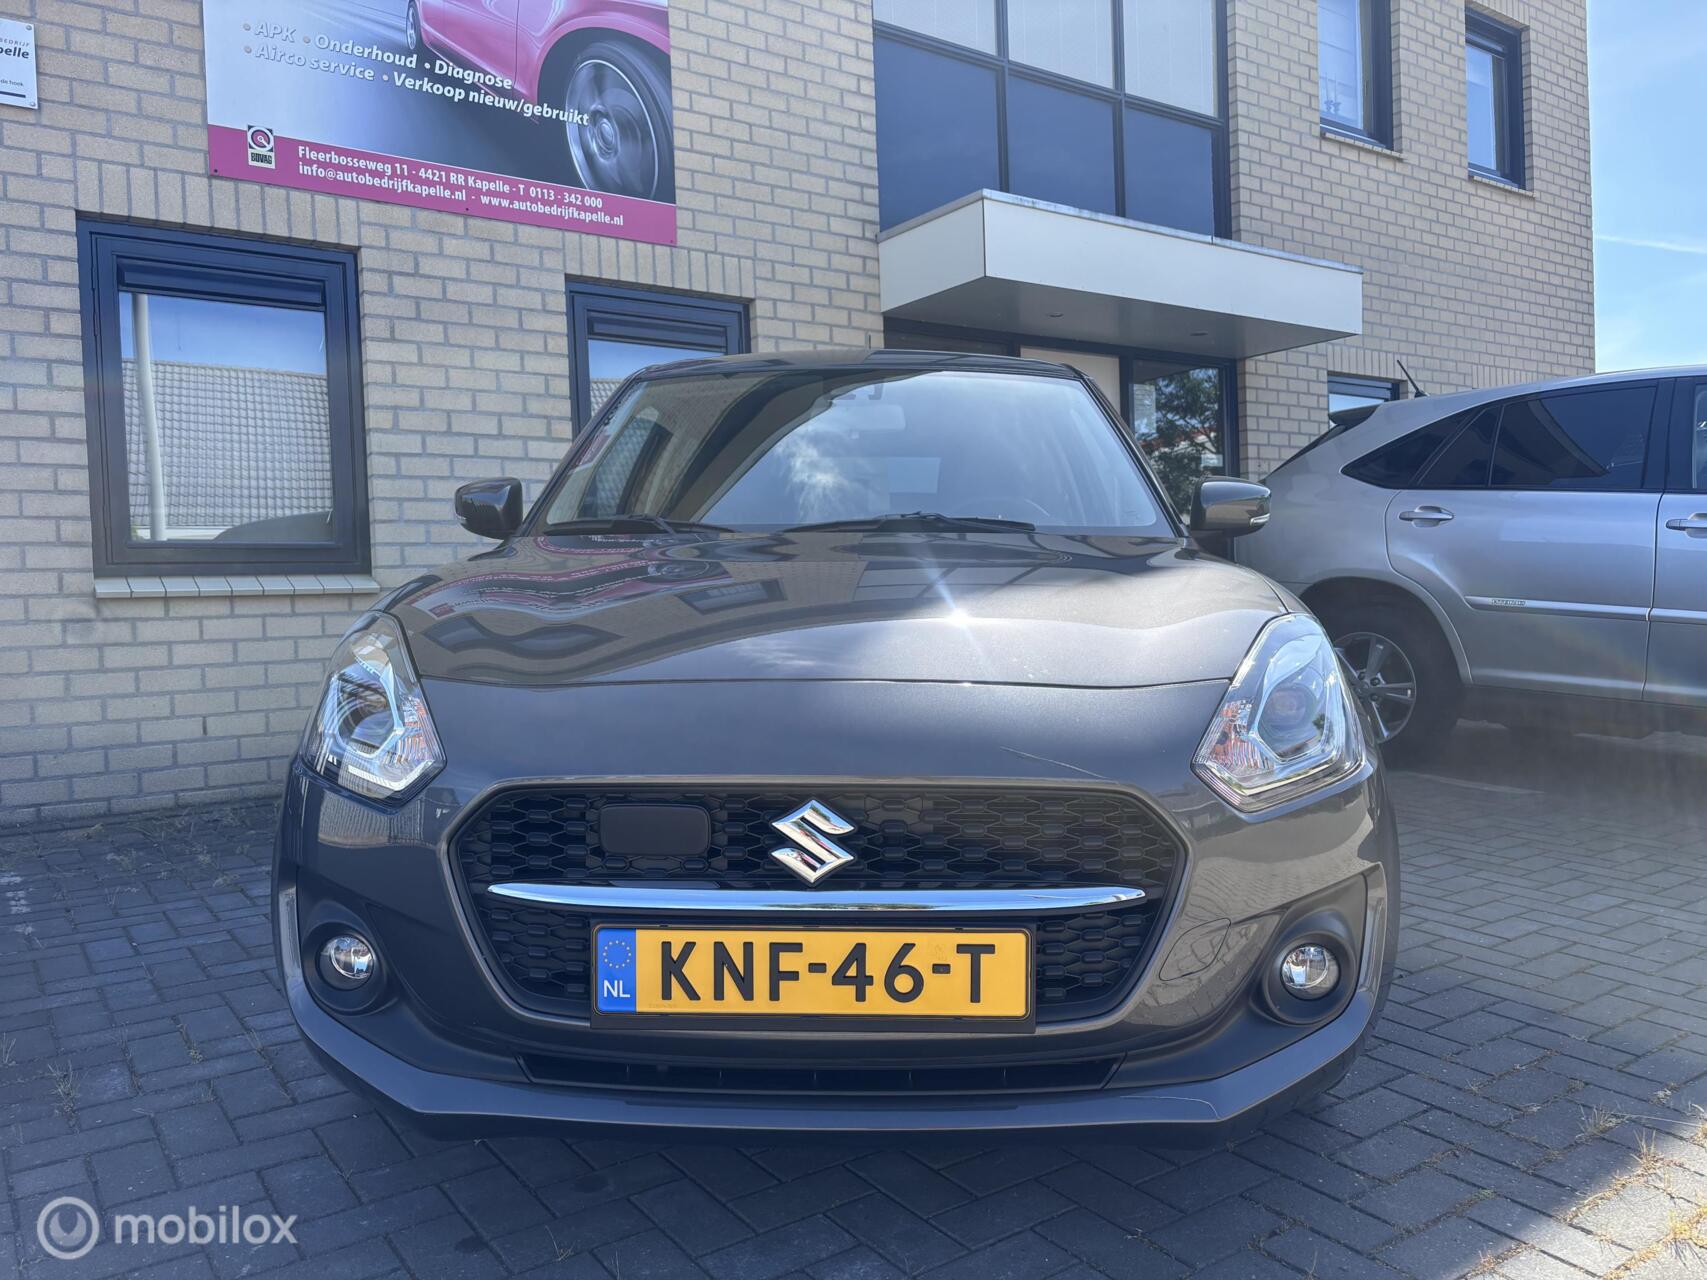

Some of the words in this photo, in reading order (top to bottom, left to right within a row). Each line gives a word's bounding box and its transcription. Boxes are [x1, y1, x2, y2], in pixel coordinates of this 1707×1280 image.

[255, 21, 297, 43] APK
[314, 34, 417, 69] Onderhoud
[434, 59, 513, 90] Diagnose
[255, 43, 306, 67] Airco
[309, 56, 375, 81] service
[393, 71, 466, 102] Verkoop
[468, 89, 590, 126] nieuw/gebruikt
[298, 145, 392, 176] Fleerbosseweg
[394, 163, 409, 176] 11
[418, 167, 447, 183] 4421
[450, 172, 466, 187] RR
[467, 176, 510, 195] Kapelle
[518, 184, 526, 196] T
[529, 186, 556, 201] 0113
[563, 193, 582, 206] 342
[584, 196, 603, 209] 000
[299, 162, 467, 201] info@autobedrijfkapelle.nl
[480, 194, 624, 227] www.autobedrijfkapelle.nl
[603, 980, 631, 998] NL
[661, 941, 996, 1004] KNF-46-T
